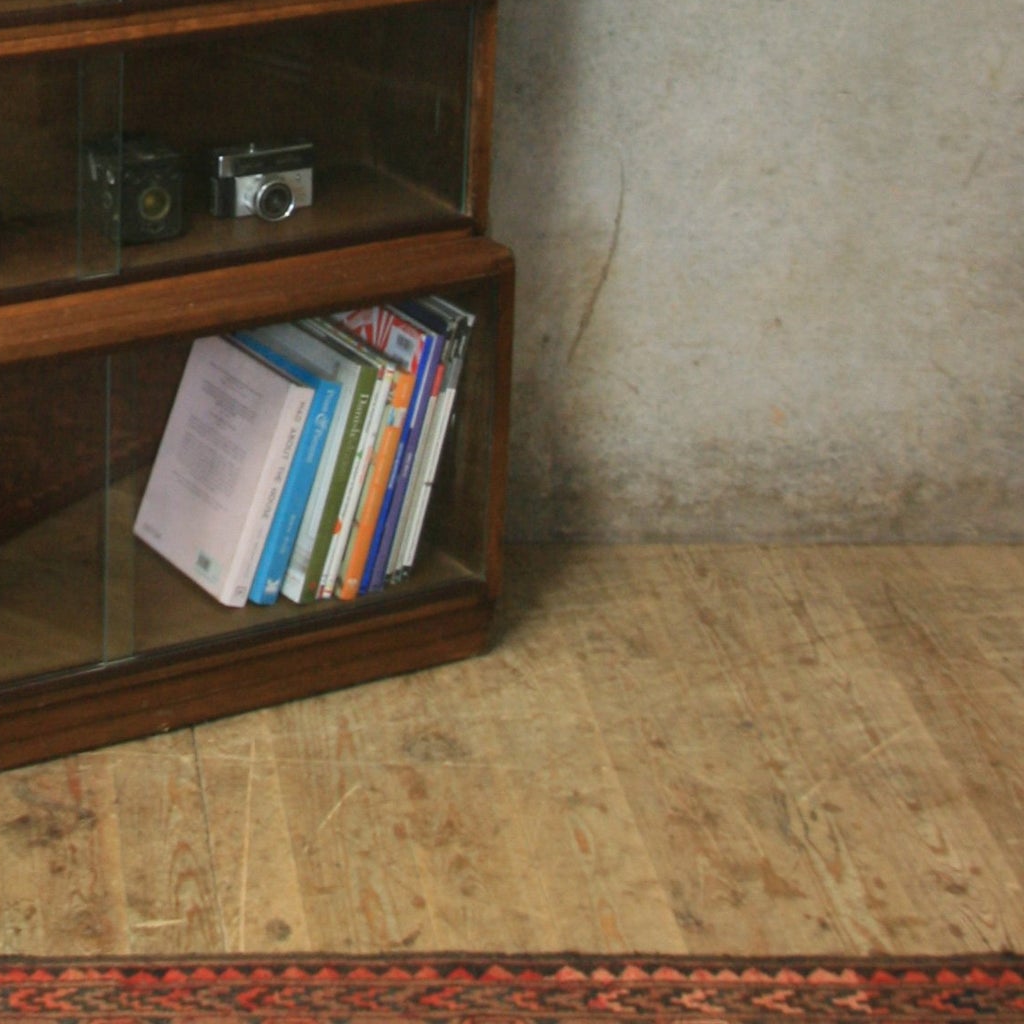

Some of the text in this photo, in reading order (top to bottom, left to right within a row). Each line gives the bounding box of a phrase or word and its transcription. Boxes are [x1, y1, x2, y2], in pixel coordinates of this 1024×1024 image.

[348, 393, 369, 438] Danish
[280, 427, 297, 459] ABOUT
[273, 465, 284, 482] THE
[261, 487, 278, 519] HOUSE
